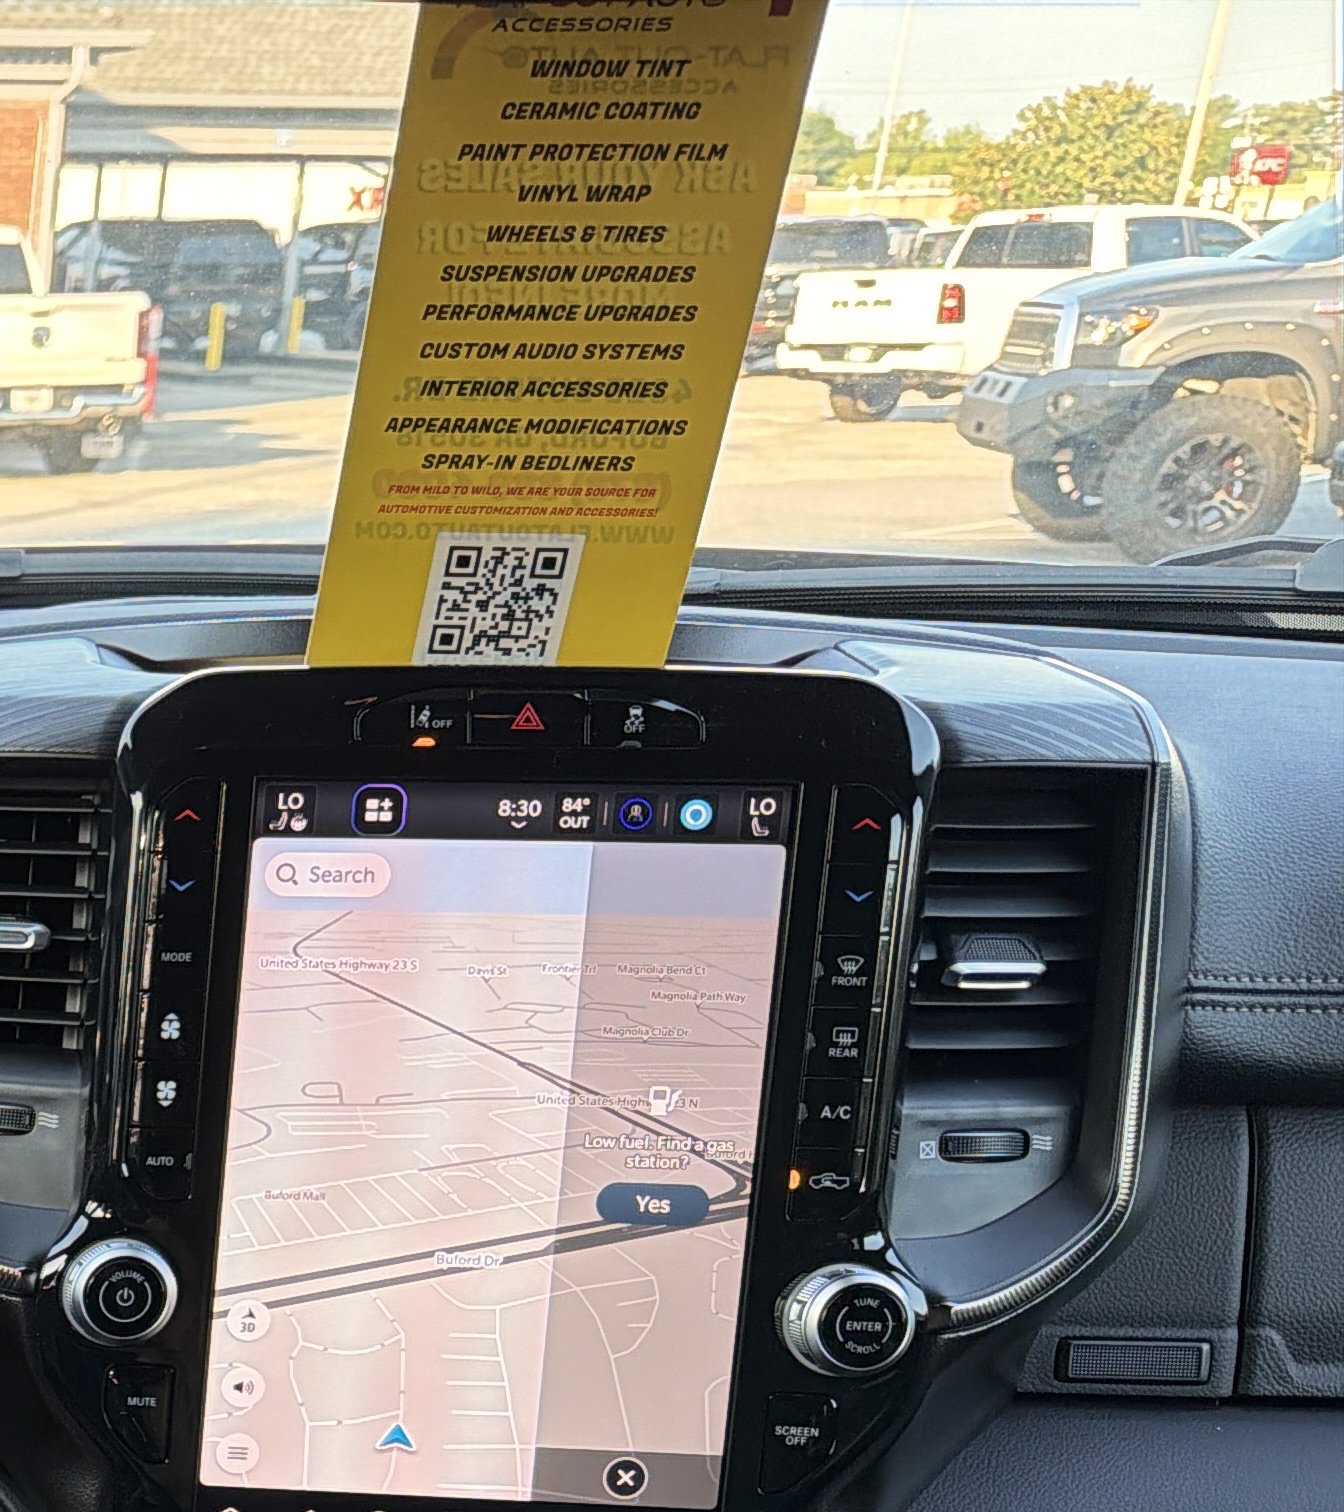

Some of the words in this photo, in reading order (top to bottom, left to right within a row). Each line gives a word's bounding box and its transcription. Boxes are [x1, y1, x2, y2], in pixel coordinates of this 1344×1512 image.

[491, 16, 674, 33] ACCESSORIES
[530, 59, 629, 79] WINDOW
[636, 59, 692, 79] TINT
[500, 102, 599, 121] CERAMIC
[604, 102, 702, 121] COATING
[457, 143, 527, 161] PAINT
[528, 143, 669, 162] PROTECTION
[674, 143, 729, 162] FILM
[517, 184, 580, 202] VINYL
[584, 184, 652, 202] WRAP
[486, 225, 575, 243] WHEELS
[580, 225, 595, 243] &
[601, 225, 667, 243] TIRES
[439, 265, 578, 283] SUSPENSION
[580, 265, 697, 283] UPGRADES
[421, 304, 582, 322] PERFORMANCE
[583, 304, 699, 322] UPGRADES
[419, 342, 509, 360] CUSTOM
[513, 342, 578, 360] AUDIO
[581, 343, 686, 361] SYSTEMS
[419, 379, 519, 397] INTERIOR
[520, 380, 669, 398] ACCESSORIES
[384, 417, 522, 434] APPEARANCE
[523, 418, 689, 436] MODIFICATIONS
[421, 453, 517, 471] SPRAY-IN
[520, 455, 636, 472] BEDLINERS
[387, 485, 421, 495] FROM
[422, 485, 451, 496] MILD
[453, 486, 468, 496] TO
[505, 486, 523, 497] WE
[525, 487, 551, 497] ARE
[552, 487, 583, 497] YOUR
[584, 487, 632, 498] SOURCE
[633, 488, 657, 498] FOR
[378, 505, 454, 515] AUTOMOTIVE
[454, 505, 549, 516] CUSTOMIZATION
[550, 506, 574, 517] AND
[432, 718, 453, 729] OFF
[623, 723, 646, 735] OFF
[277, 792, 305, 810] LO
[497, 799, 543, 818] 8:30
[749, 797, 777, 816] LO
[559, 816, 591, 829] OUT
[308, 865, 376, 884] Search
[160, 951, 193, 963] MODE
[338, 959, 392, 972] Highway
[616, 964, 665, 977] Magnolia
[831, 975, 868, 987] FRONT
[651, 991, 697, 1002] Magnolia
[724, 992, 746, 1004] Way
[603, 1026, 650, 1038] Magnolia
[651, 1027, 674, 1037] Club
[828, 1047, 858, 1058] REAR
[537, 1094, 576, 1106] United
[578, 1095, 614, 1106] States
[819, 1105, 852, 1120] A/C
[584, 1134, 618, 1149] Low
[618, 1134, 654, 1150] fuel.
[657, 1136, 692, 1151] Find
[694, 1140, 704, 1151] a
[706, 1140, 735, 1155] gas
[145, 1156, 175, 1167] AUTO
[624, 1153, 689, 1170] station?
[635, 1194, 671, 1214] Yes
[435, 1254, 481, 1267] Buford
[108, 1269, 147, 1284] VOLUME
[853, 1297, 881, 1308] TUNE
[239, 1322, 256, 1333] 3D
[845, 1321, 882, 1332] ENTER
[845, 1340, 881, 1355] SCROLL
[127, 1396, 157, 1407] MUTE
[774, 1425, 820, 1437] SCREEN
[785, 1436, 808, 1446] OFF
